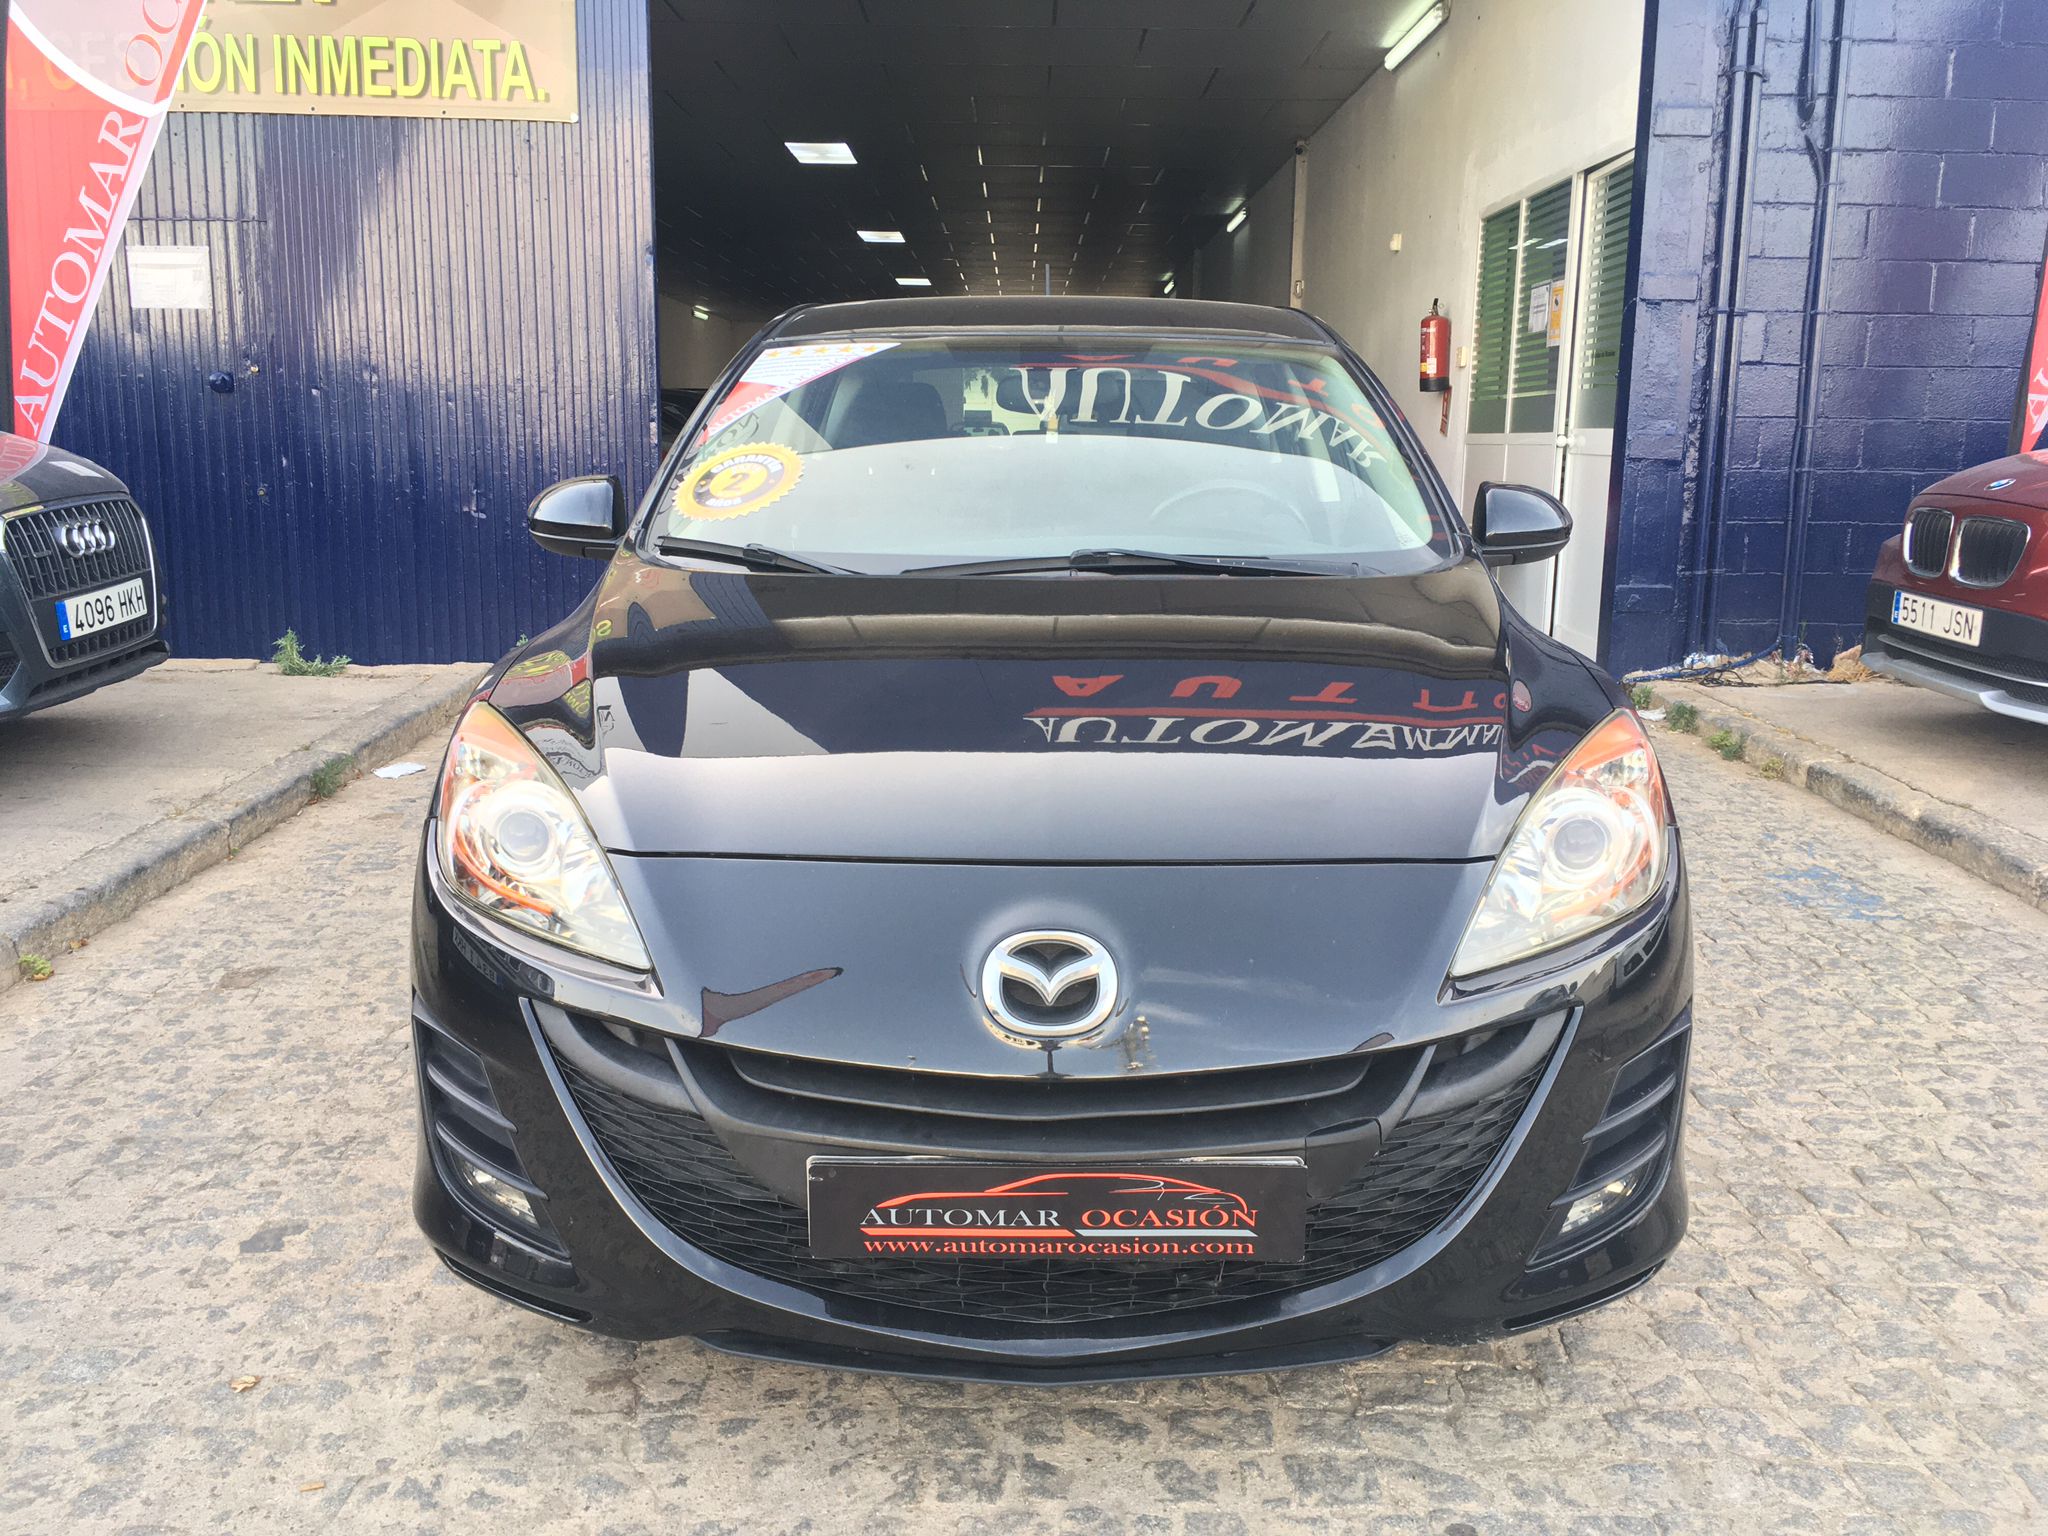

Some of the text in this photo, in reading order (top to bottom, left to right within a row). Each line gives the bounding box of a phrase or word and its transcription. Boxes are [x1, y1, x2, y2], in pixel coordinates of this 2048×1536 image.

[272, 33, 546, 101] INMEDIATA.
[15, 110, 145, 436] AUTOMAR
[75, 595, 115, 631] 4096
[117, 584, 146, 618] HKH
[1901, 597, 1935, 630] 5511
[1943, 609, 1975, 640] JSN
[860, 1204, 1258, 1227] AUTOMAR OCASIÓN
[864, 1237, 1254, 1255] www.automarocasion.com
